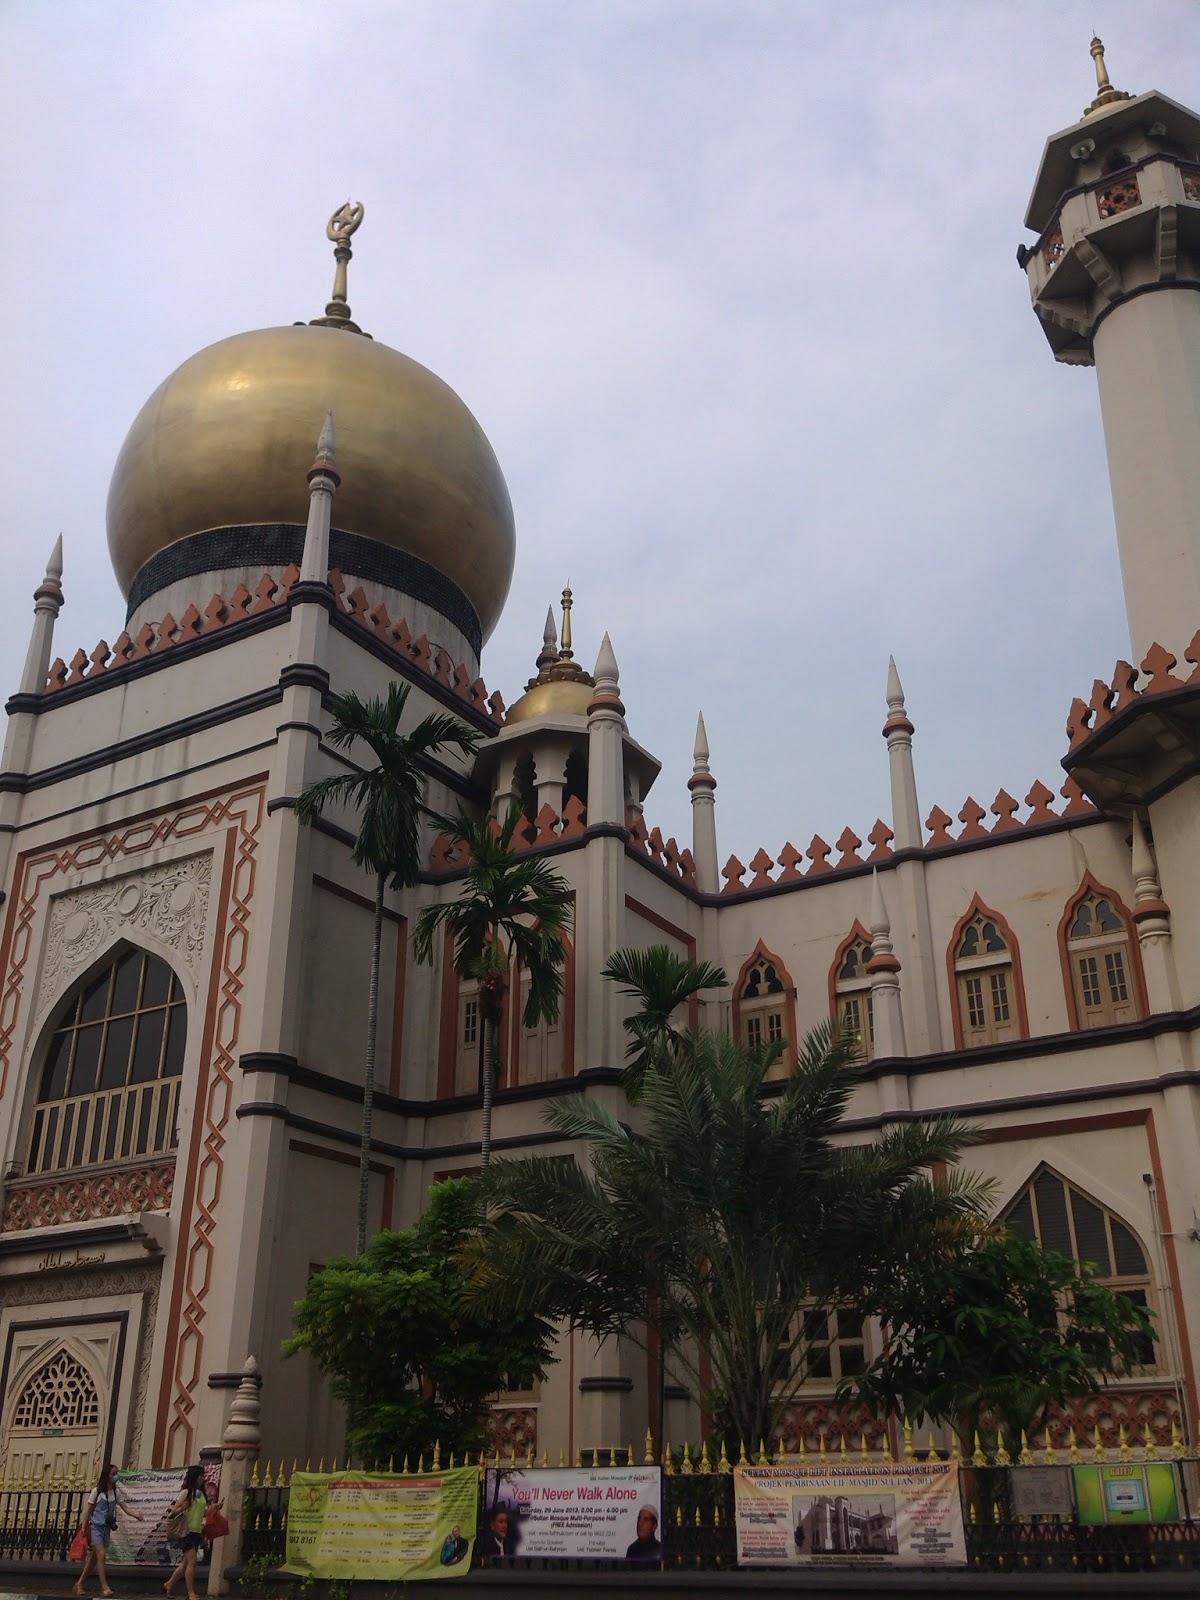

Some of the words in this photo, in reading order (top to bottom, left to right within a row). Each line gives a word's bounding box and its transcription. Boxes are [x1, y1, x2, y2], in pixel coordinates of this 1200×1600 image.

[741, 1468, 772, 1477] SULTAN
[772, 1468, 808, 1479] MOSQUE
[809, 1467, 828, 1477] LIFT
[829, 1466, 890, 1477] INSTALLATION
[892, 1465, 931, 1476] PROJECT
[1110, 1466, 1128, 1477] GATE
[754, 1479, 782, 1489] PROJEK
[784, 1479, 833, 1488] PEMBINAAN
[848, 1477, 878, 1488] MASJID
[880, 1476, 914, 1486] SULTAN
[917, 1476, 933, 1485] 2013
[512, 1487, 540, 1501] You'll
[541, 1487, 575, 1501] Never
[577, 1486, 603, 1500] Walk
[605, 1486, 638, 1500] Alone
[519, 1507, 543, 1515] Saturday,
[549, 1514, 569, 1522] Mosque
[569, 1514, 605, 1522] Multi-Purpose
[550, 1521, 565, 1529] (FREE
[565, 1521, 593, 1529] Admission)
[300, 1536, 317, 1544] 8161
